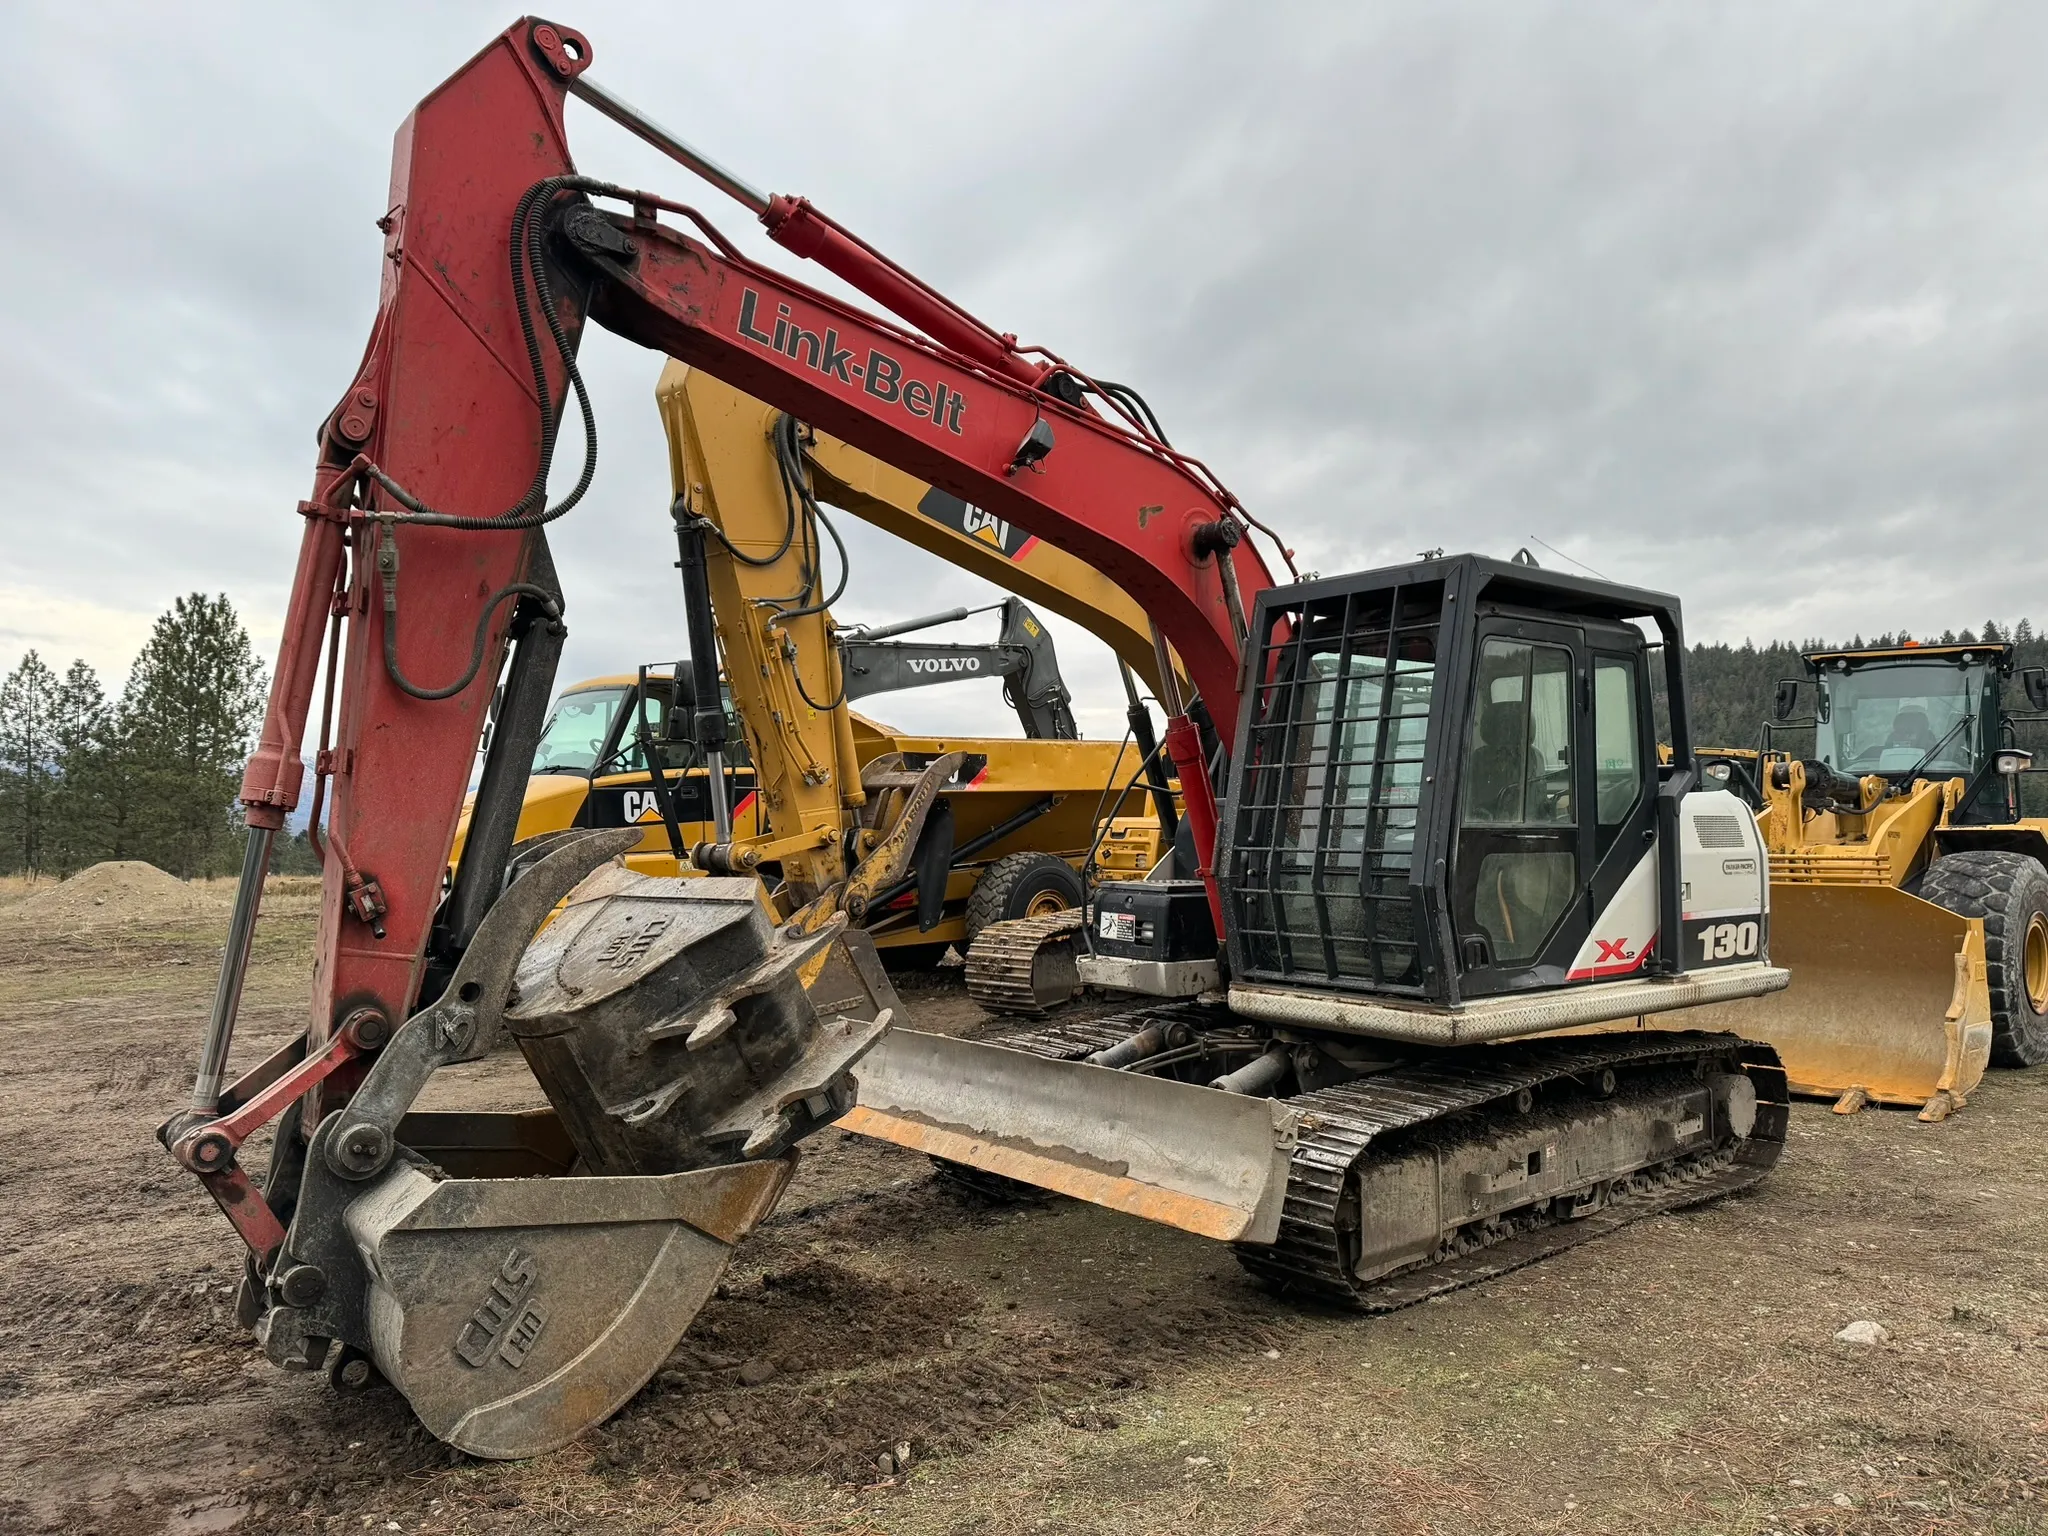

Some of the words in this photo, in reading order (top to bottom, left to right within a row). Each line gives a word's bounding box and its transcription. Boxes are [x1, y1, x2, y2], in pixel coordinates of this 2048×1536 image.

[736, 287, 966, 436] Link-Belt
[906, 657, 980, 673] VOLVO
[623, 791, 672, 824] CA
[1697, 921, 1759, 961] 130
